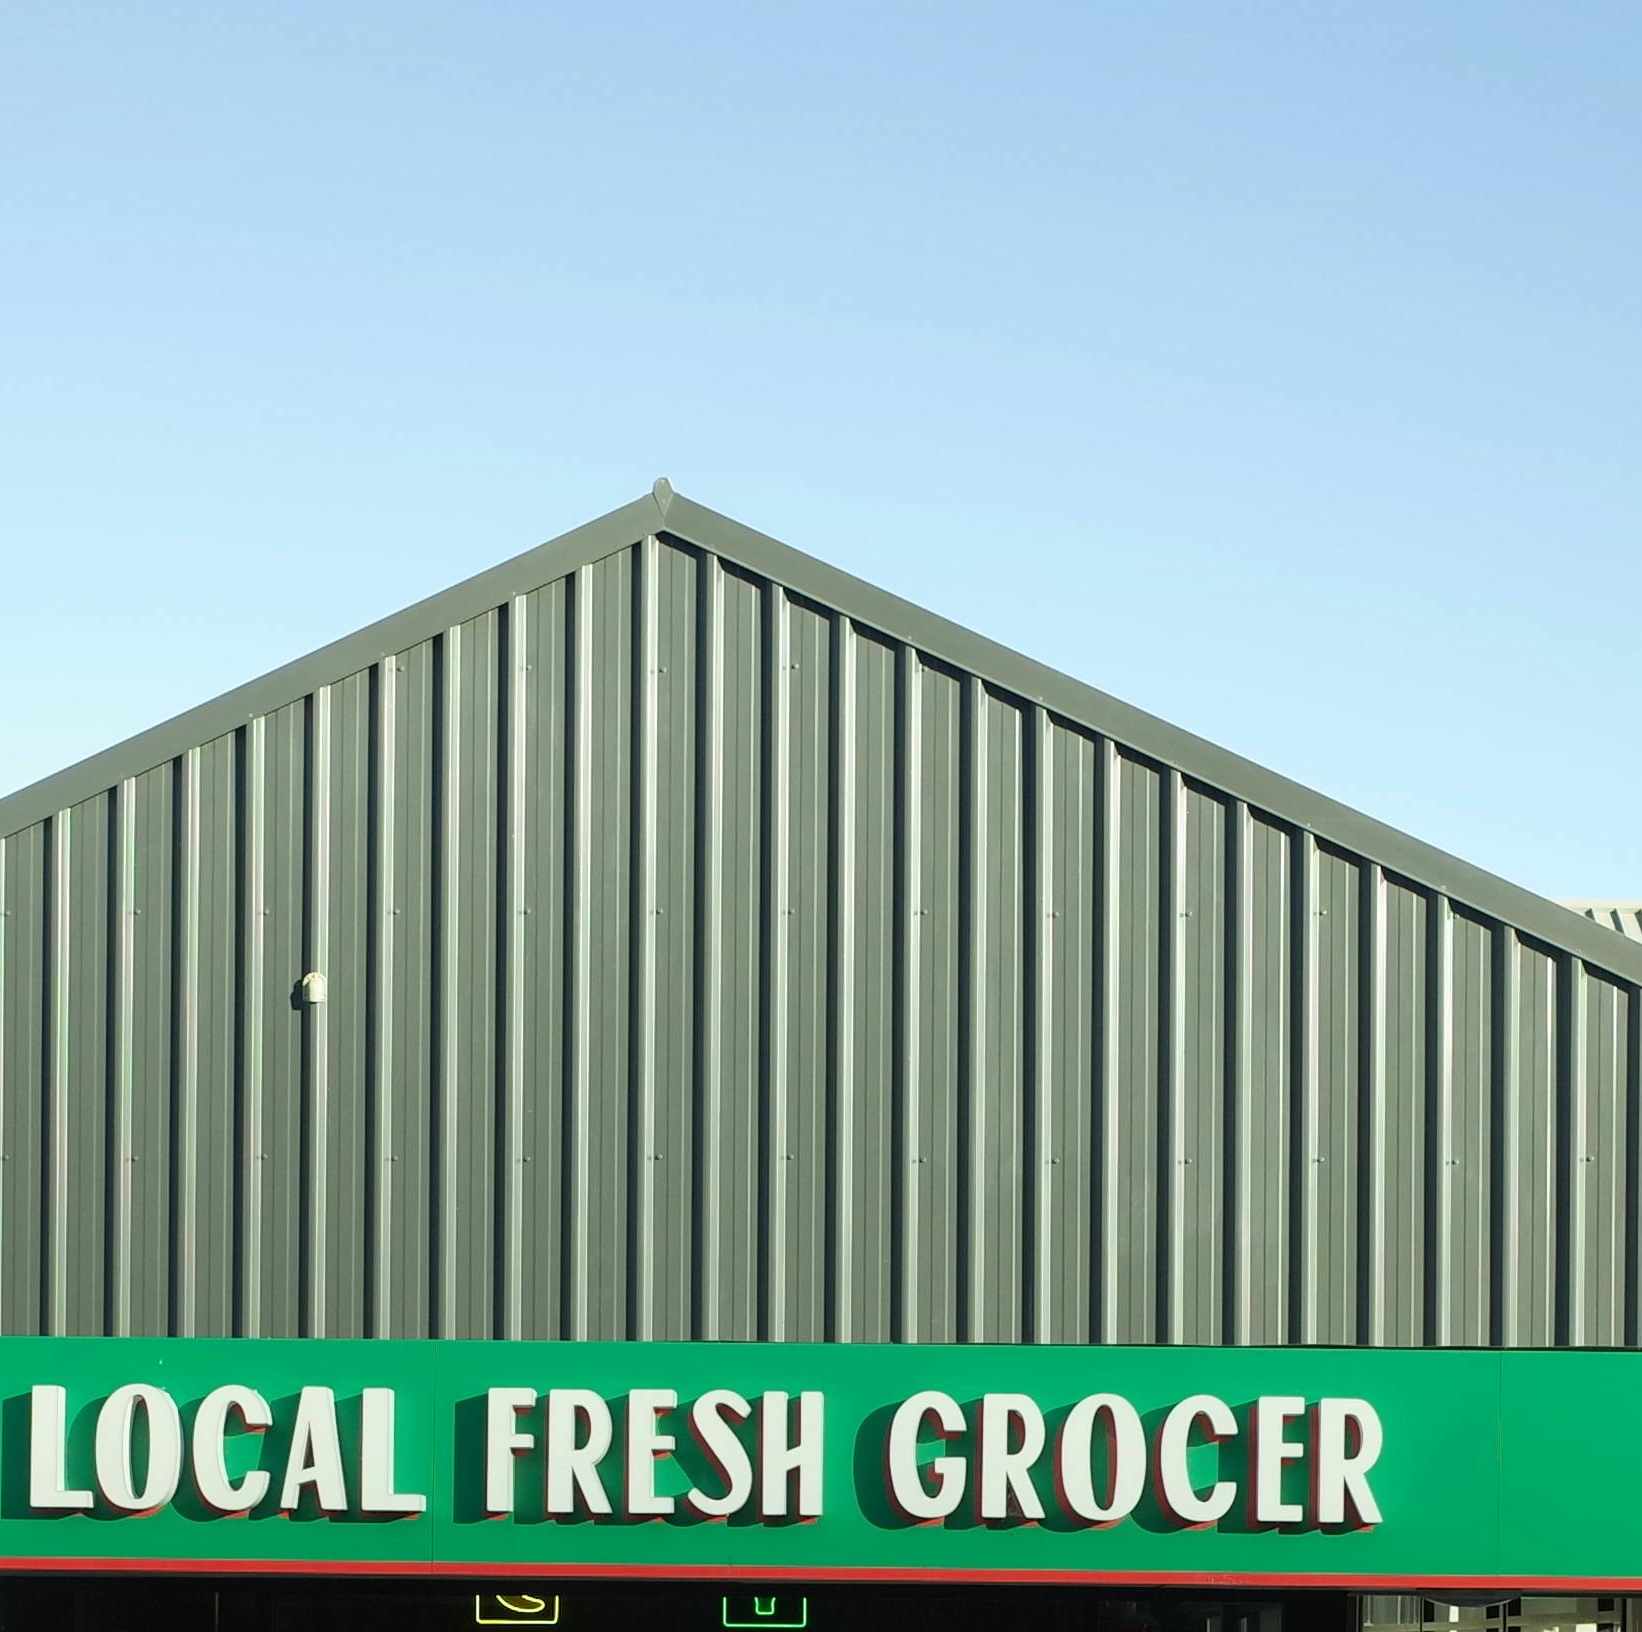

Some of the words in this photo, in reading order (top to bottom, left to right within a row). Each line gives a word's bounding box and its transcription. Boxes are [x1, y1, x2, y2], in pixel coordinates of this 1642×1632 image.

[31, 1383, 428, 1513] LOCAL
[485, 1387, 824, 1519] FRESH
[886, 1390, 1384, 1526] GROCER
